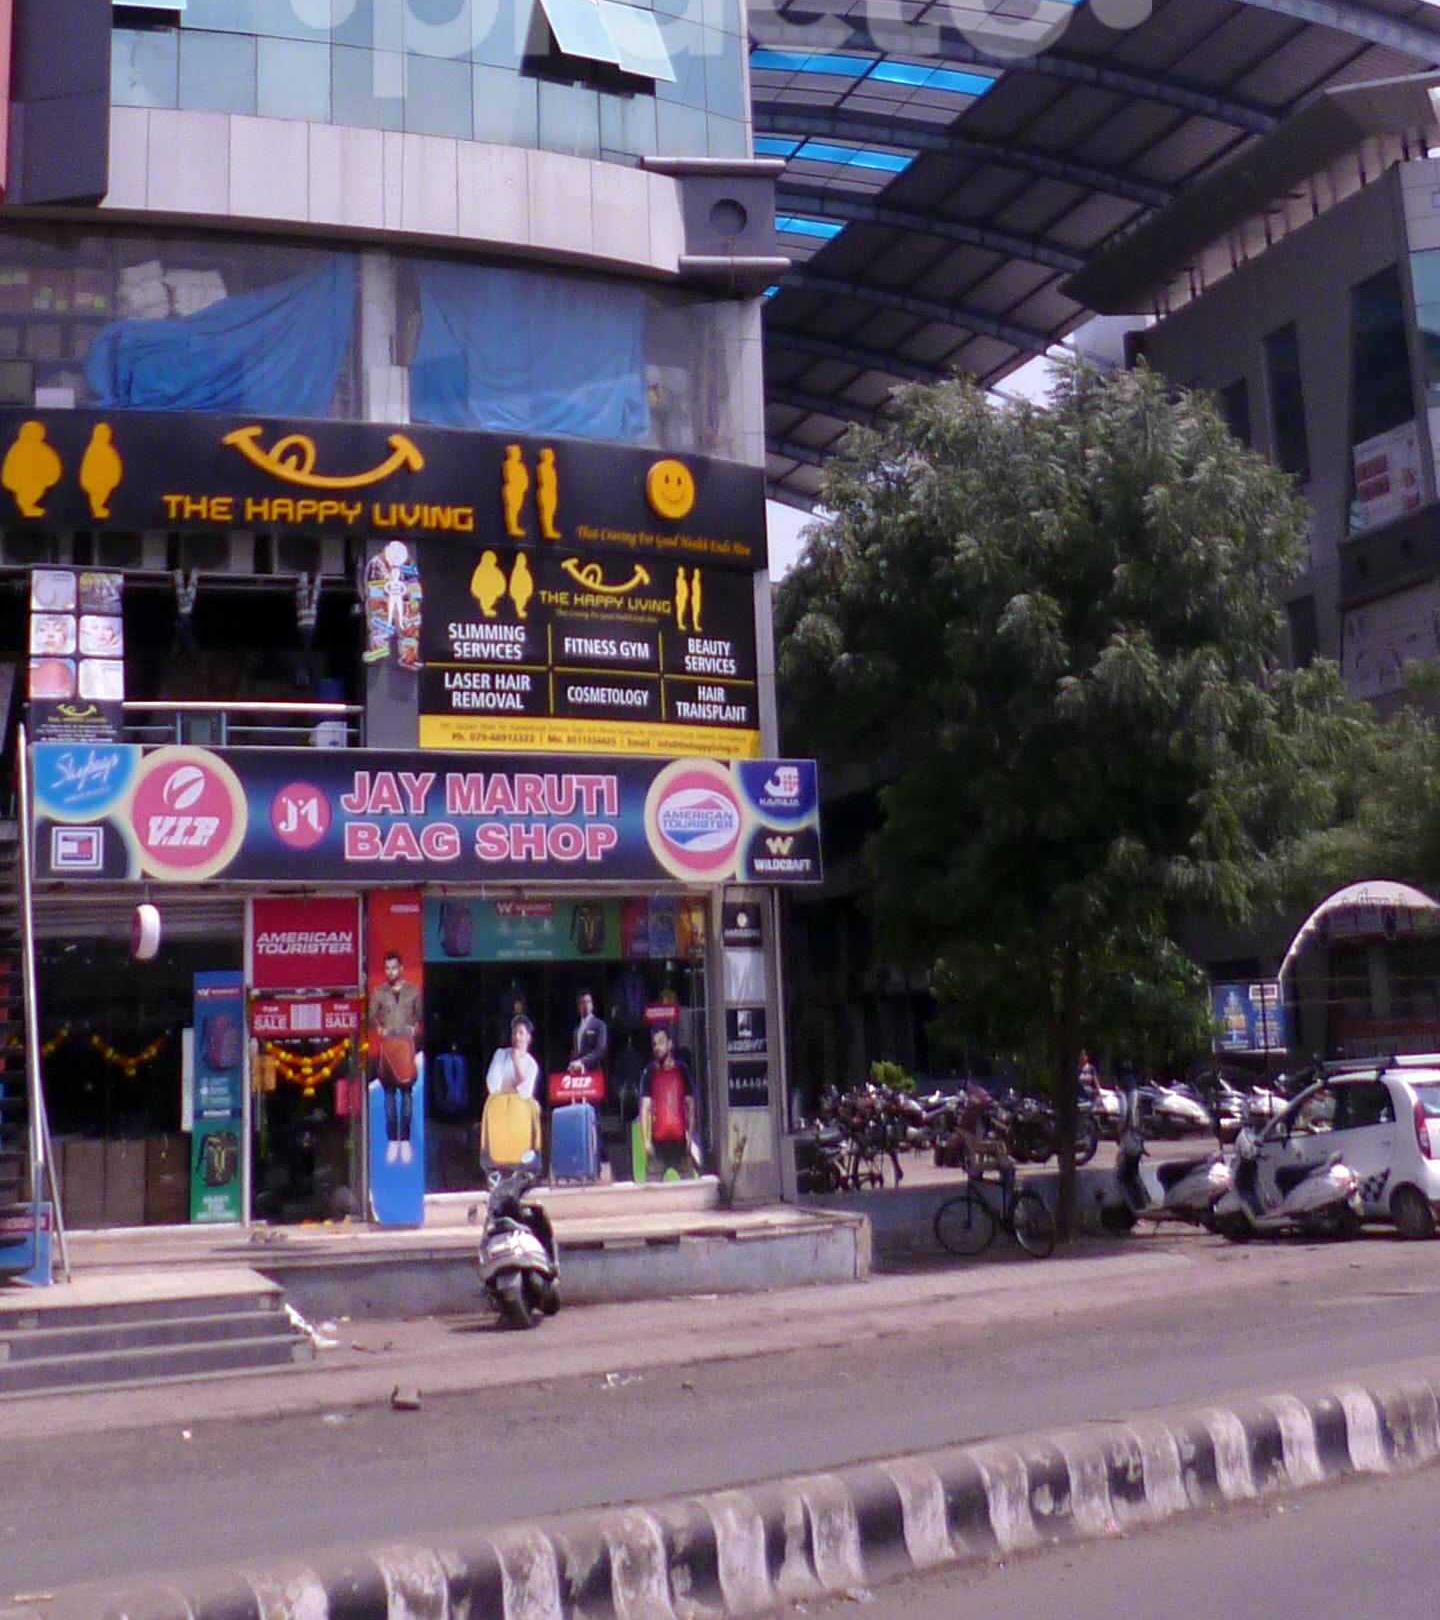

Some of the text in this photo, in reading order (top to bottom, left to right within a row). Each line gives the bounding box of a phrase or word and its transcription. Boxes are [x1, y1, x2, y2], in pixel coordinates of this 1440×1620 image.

[162, 494, 475, 531] THE HAPPY LIVING
[539, 590, 671, 614] THE HAPPY LIVING
[448, 622, 526, 642] SLIMMING
[453, 641, 522, 660] SERVICES
[564, 637, 650, 659] FITNESS GYM
[688, 637, 731, 656] BEAUTY
[684, 656, 737, 675] SERVICES
[444, 672, 531, 692] LASER HAIR
[451, 691, 525, 711] REMOVAL
[567, 685, 649, 707] COSMETOLOGY
[697, 685, 725, 703] HAIR
[676, 700, 748, 723] TRANSPLANT
[340, 771, 618, 816] JAY MARUTI
[662, 810, 733, 820] AMERICAN
[663, 819, 733, 829] TOURISTER
[345, 822, 618, 861] BAG SHOP
[753, 858, 811, 872] WILDCRAFT
[257, 931, 354, 944] AMERICAN
[256, 942, 353, 955] TOURISTER
[253, 1016, 288, 1031] SALE
[325, 1015, 358, 1029] SALE
